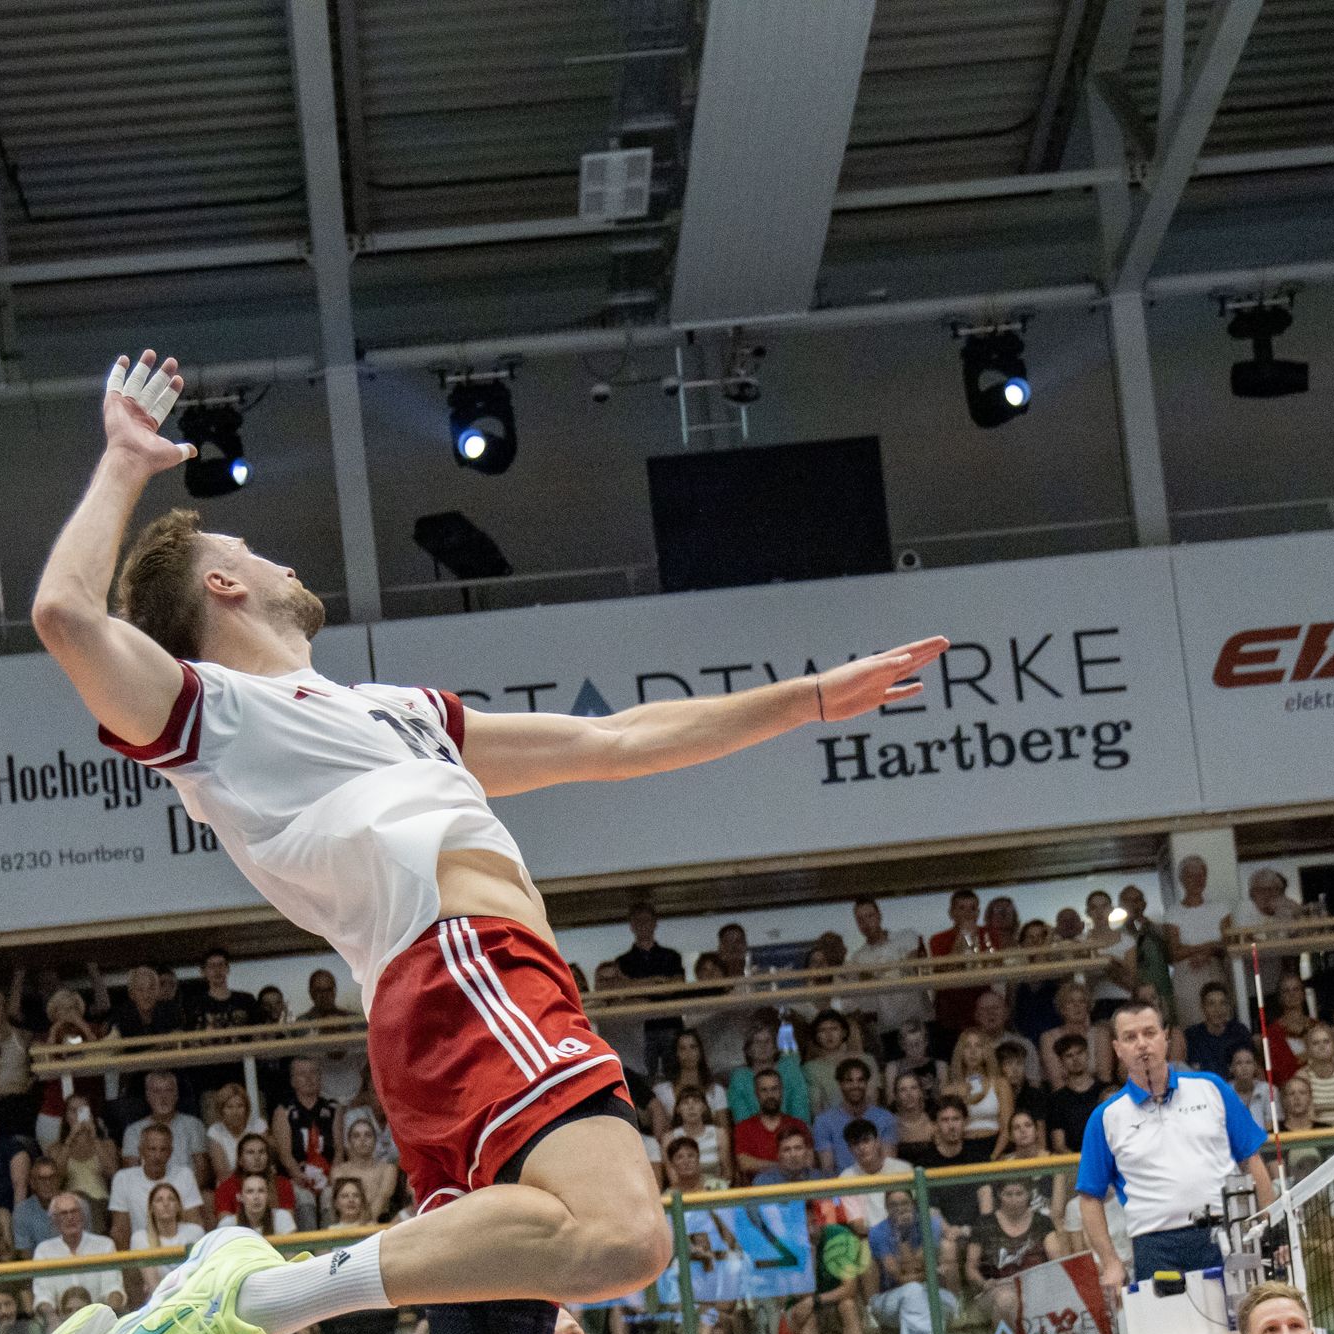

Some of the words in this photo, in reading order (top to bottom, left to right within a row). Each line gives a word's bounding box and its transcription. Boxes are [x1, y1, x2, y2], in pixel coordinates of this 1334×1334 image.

[819, 719, 1132, 785] Hartberg
[167, 804, 219, 857] Da
[0, 850, 52, 873] 8230
[59, 845, 145, 869] Hartberg
